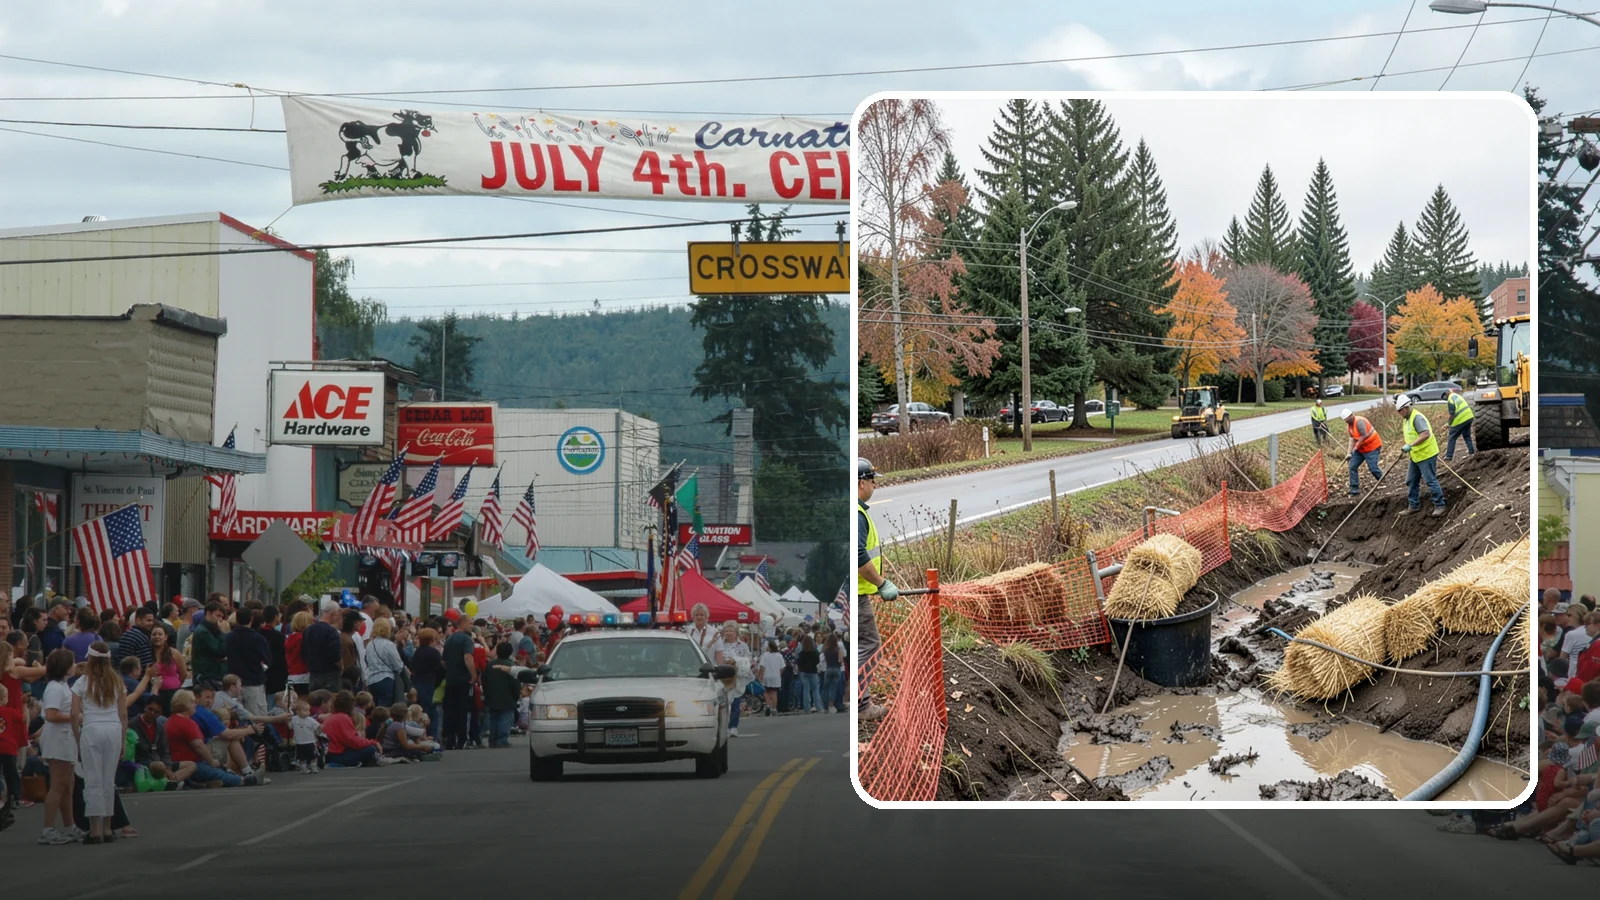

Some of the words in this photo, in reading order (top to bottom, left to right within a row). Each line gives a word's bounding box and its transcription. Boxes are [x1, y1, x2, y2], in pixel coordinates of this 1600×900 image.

[481, 140, 604, 192] JULY
[632, 150, 746, 198] 4th.
[697, 254, 850, 280] CROSSWA
[283, 380, 373, 420] ACE
[405, 410, 452, 423] CEDAR
[461, 409, 486, 421] LOG
[284, 421, 370, 436] Hardware
[416, 428, 477, 447] Coca-Cola
[83, 486, 94, 494] St.
[96, 485, 124, 495] Vincent
[126, 486, 136, 495] de
[137, 486, 155, 495] Paul
[688, 526, 741, 535] CRNATION
[699, 535, 730, 543] GLASS
